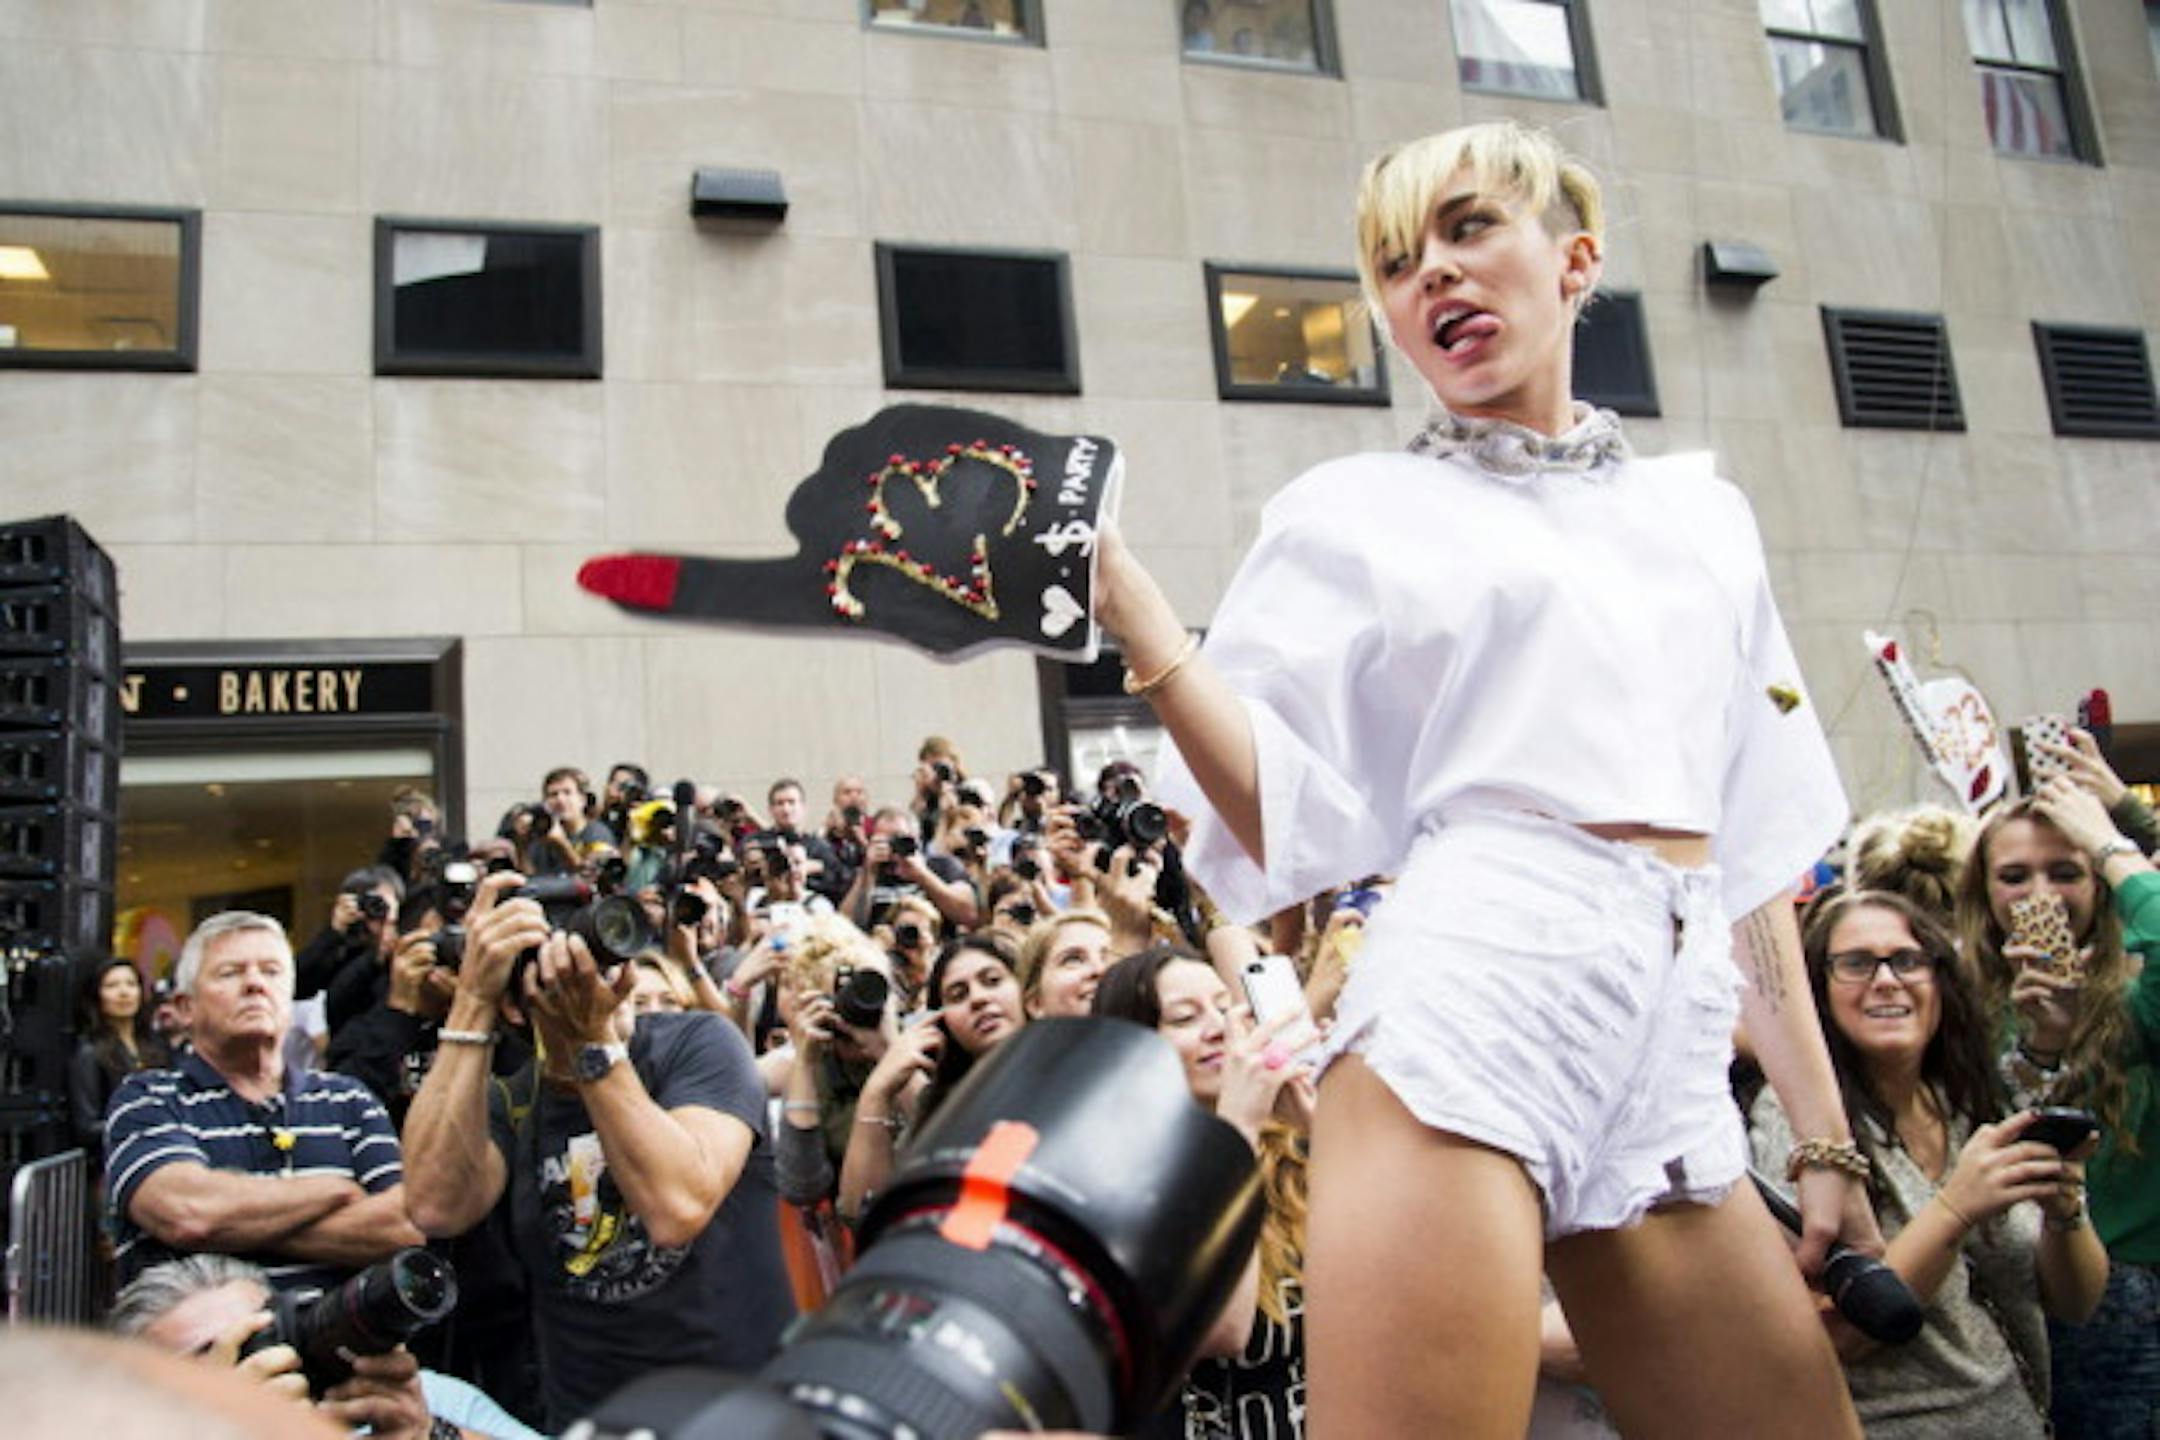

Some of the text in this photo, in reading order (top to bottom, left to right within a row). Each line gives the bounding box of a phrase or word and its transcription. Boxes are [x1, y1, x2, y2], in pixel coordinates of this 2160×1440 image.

[1058, 437, 1099, 505] PARTY
[823, 439, 1038, 620] 23
[220, 670, 362, 714] BAKERY
